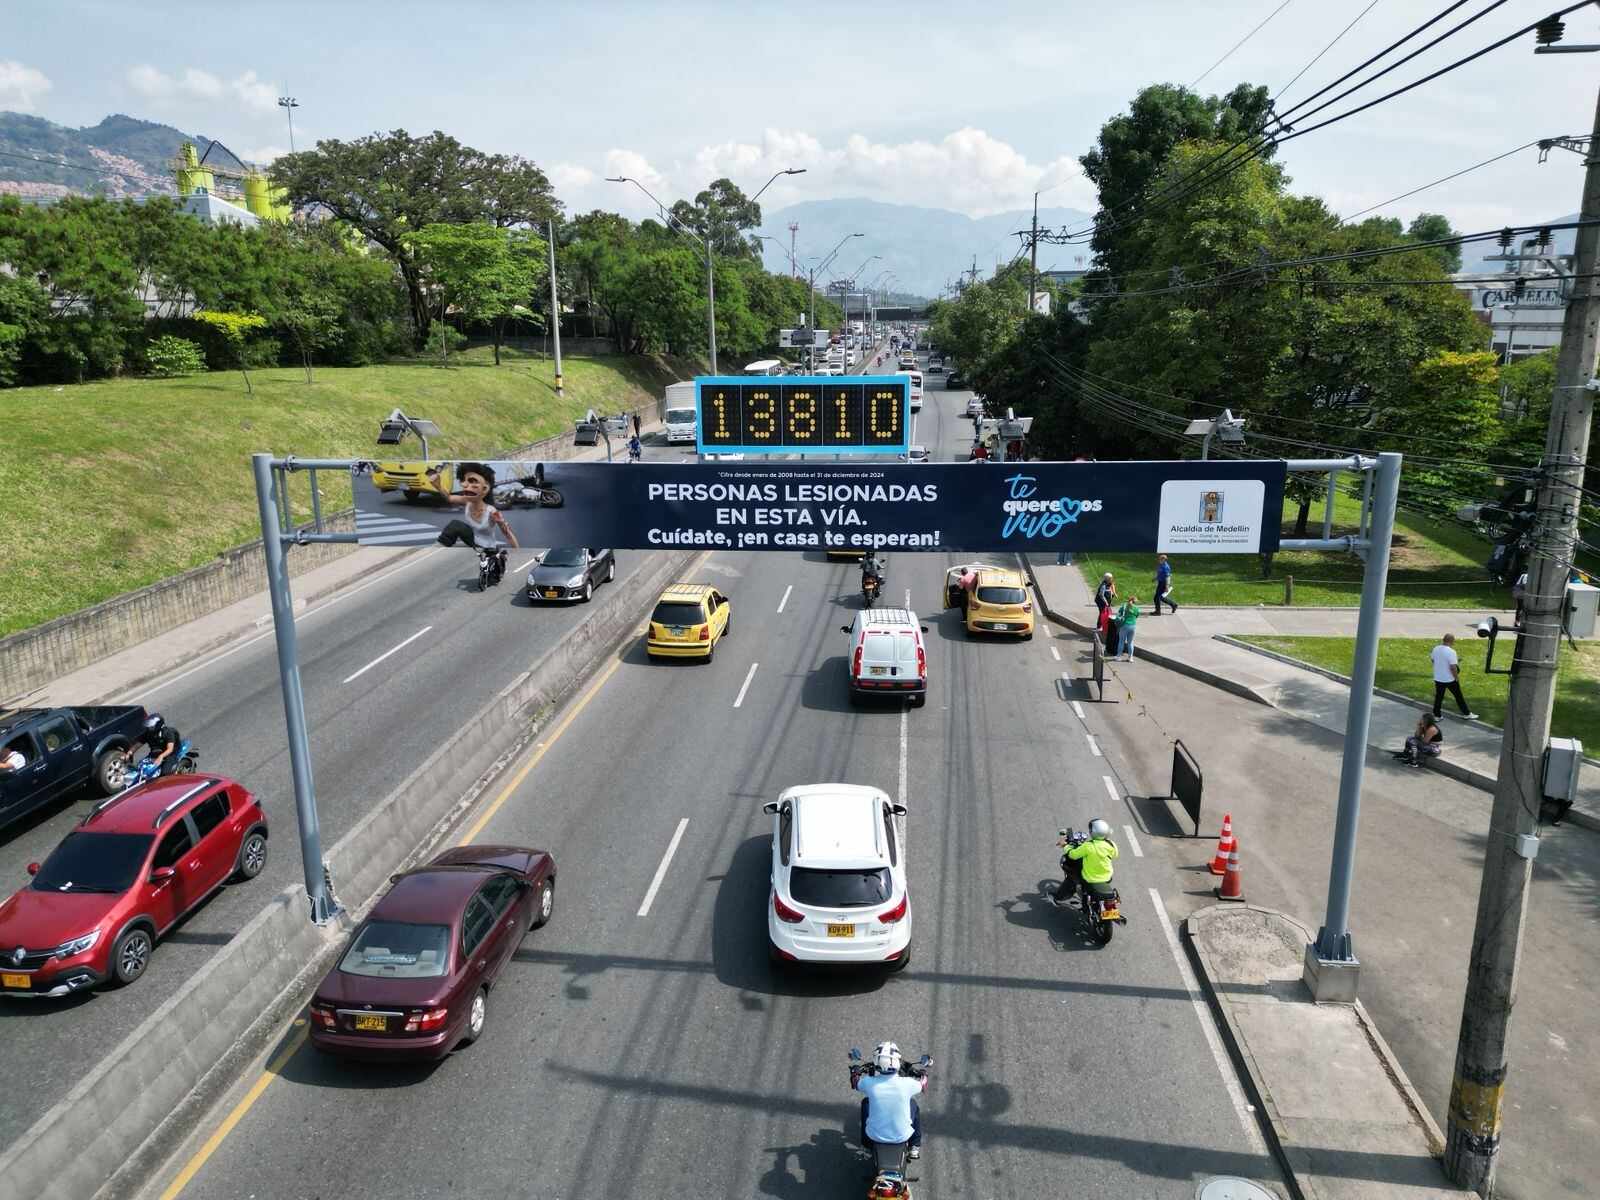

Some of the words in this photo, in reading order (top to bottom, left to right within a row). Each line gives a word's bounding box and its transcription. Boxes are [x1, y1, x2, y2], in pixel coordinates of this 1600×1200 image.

[713, 392, 898, 438] 13810
[648, 483, 777, 502] PERSONAS
[785, 484, 938, 502] LESIONADAS
[1004, 473, 1038, 499] te
[716, 508, 747, 525] EN
[754, 508, 813, 526] ESTA
[819, 504, 868, 526] VÍA.
[647, 527, 732, 548] Cuídate,
[737, 532, 769, 548] ¡en
[773, 532, 819, 546] casa
[824, 530, 846, 546] te
[850, 530, 940, 549] esperan!
[1204, 525, 1215, 533] de
[357, 1016, 386, 1027] BRT-215
